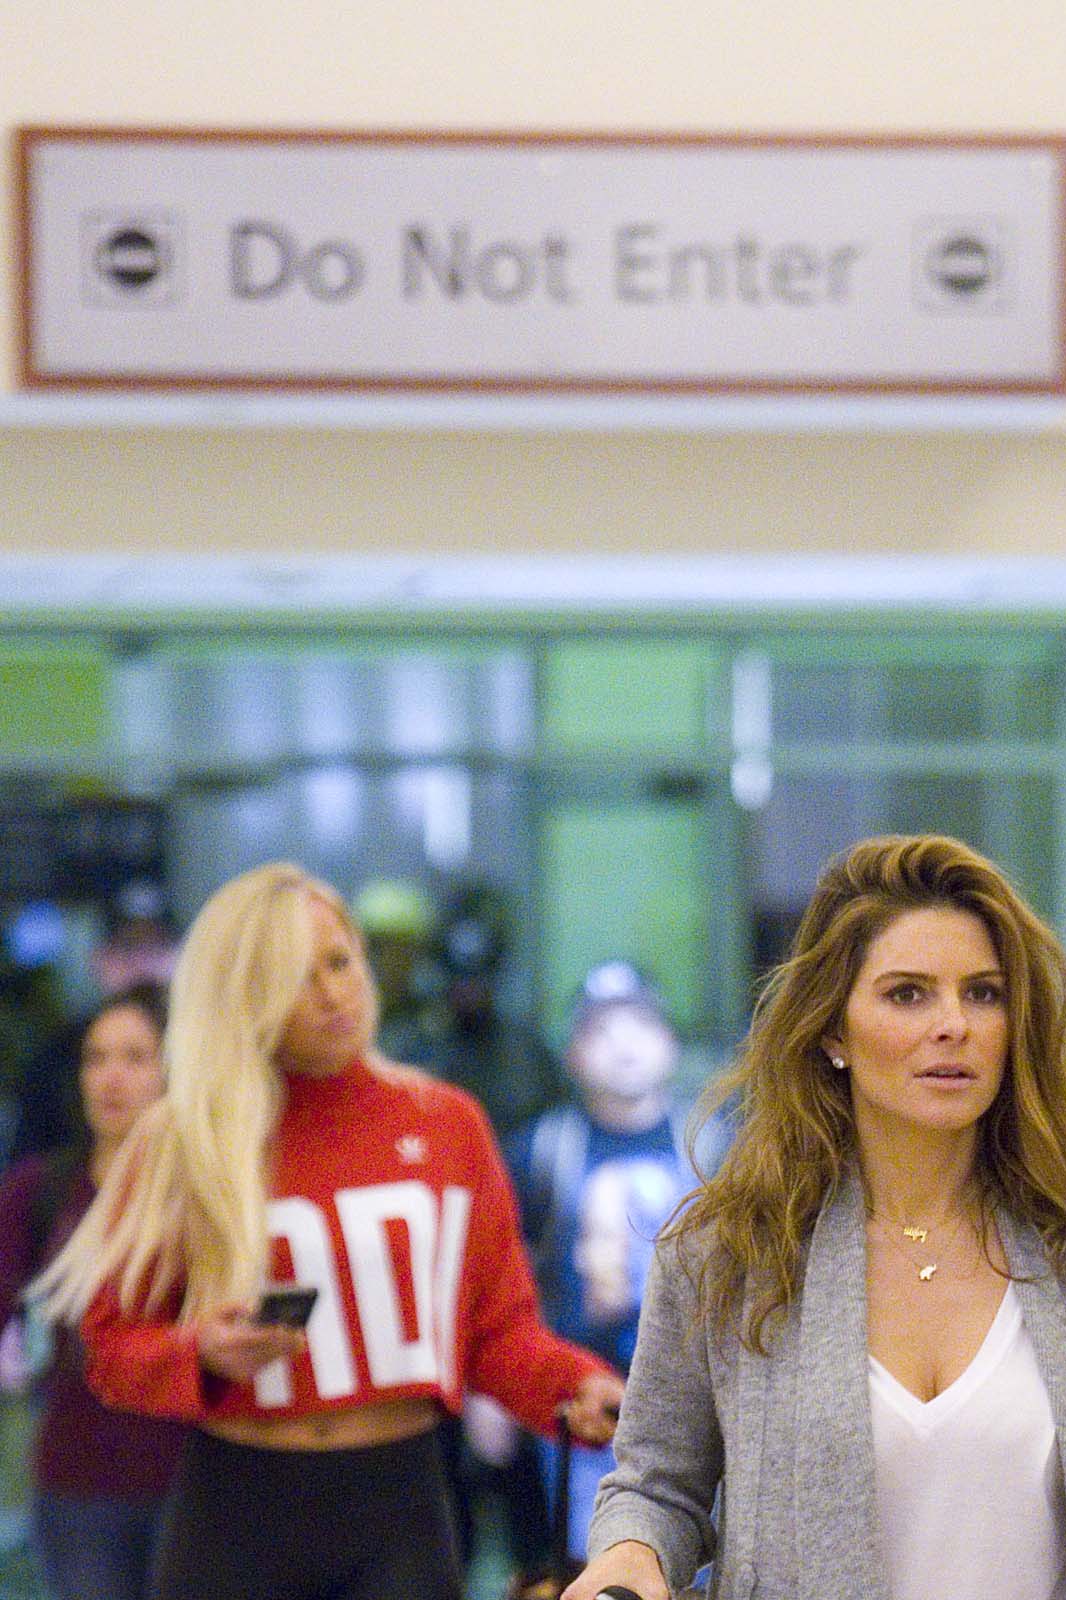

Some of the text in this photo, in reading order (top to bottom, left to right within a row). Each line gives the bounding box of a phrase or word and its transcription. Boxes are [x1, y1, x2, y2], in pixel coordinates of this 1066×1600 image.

[225, 216, 866, 308] Do Not Enter
